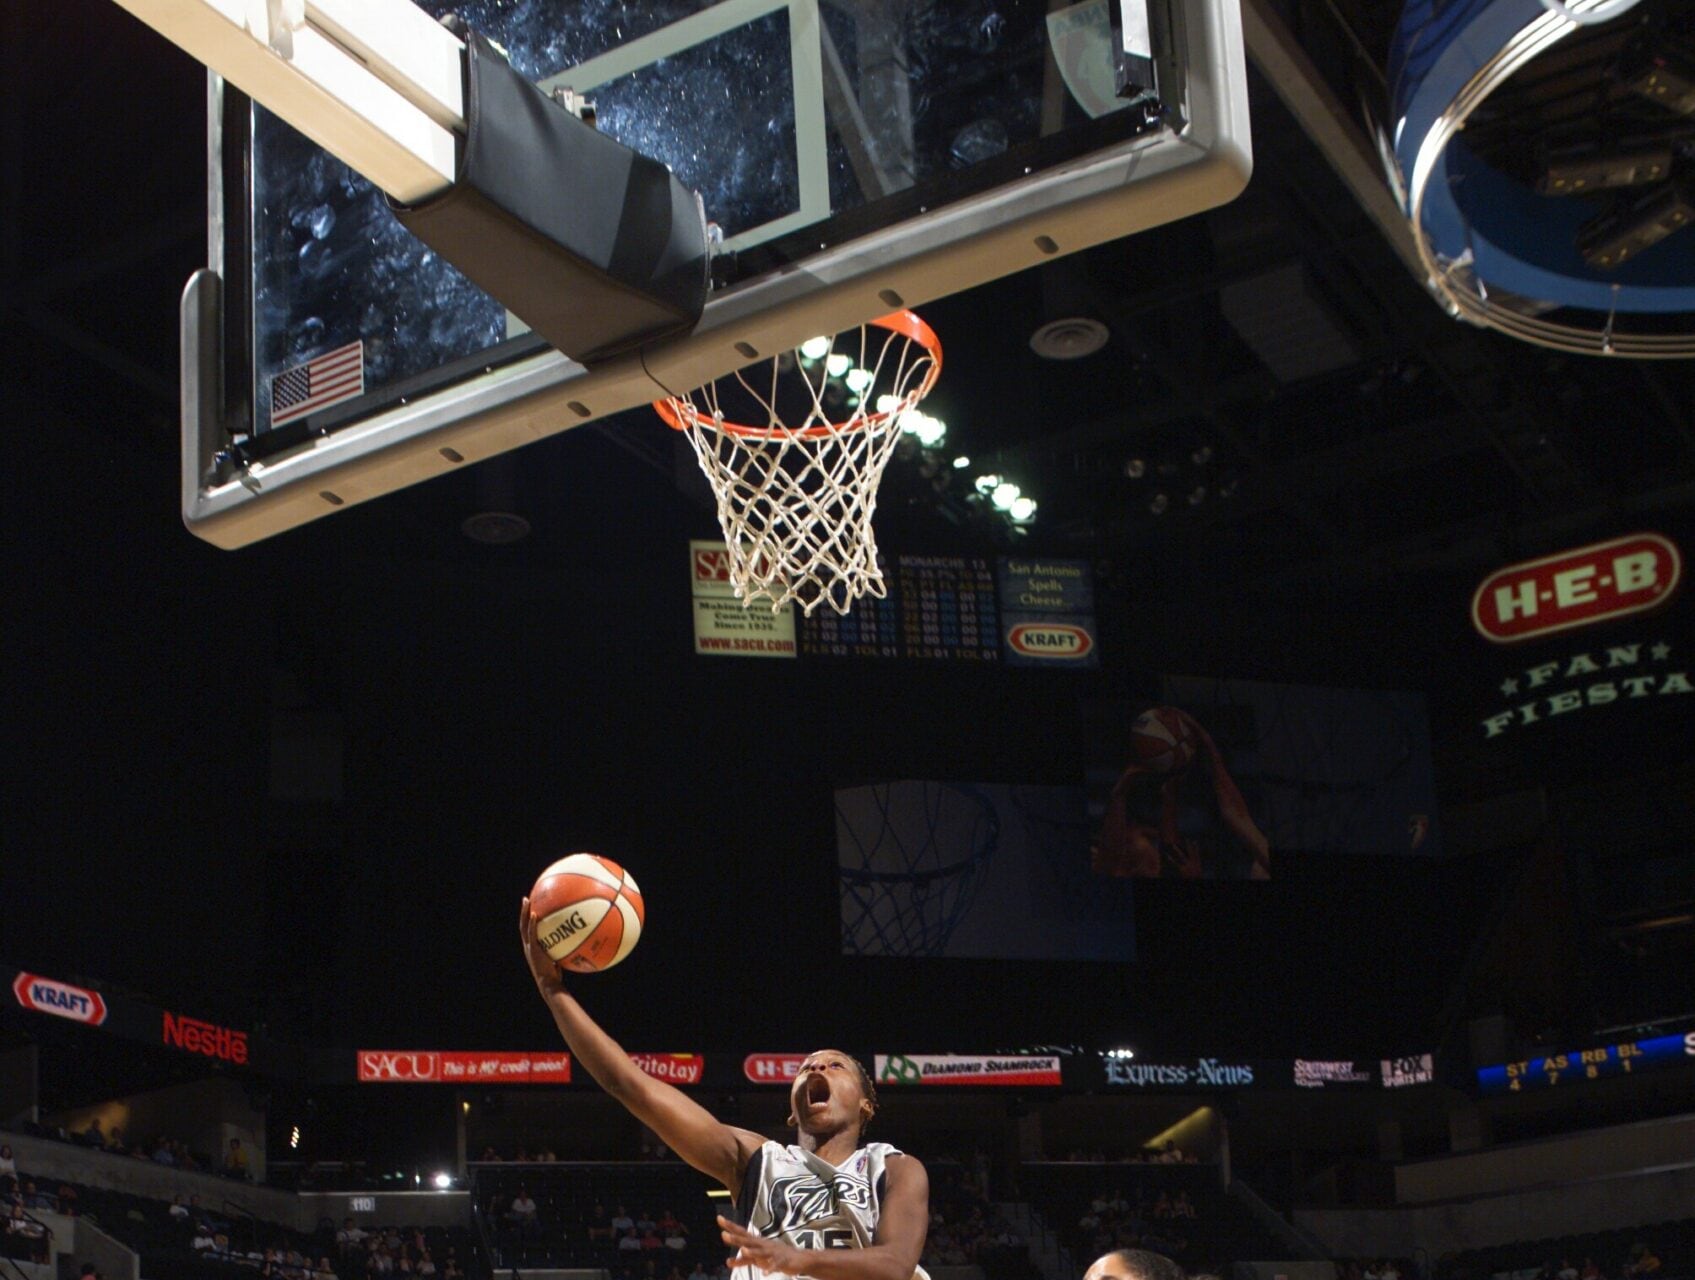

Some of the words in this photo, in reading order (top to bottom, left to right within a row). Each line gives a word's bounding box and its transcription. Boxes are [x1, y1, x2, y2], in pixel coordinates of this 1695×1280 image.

[1008, 562, 1030, 575] San
[1033, 563, 1080, 577] Antonio
[1028, 578, 1063, 592] Spells
[1495, 551, 1658, 624] H-E-B
[698, 637, 795, 652] www.sacu.com
[1024, 633, 1076, 647] KRAFT
[1526, 643, 1644, 689] FAN
[1481, 673, 1695, 739] FIESTA
[32, 983, 90, 1016] KRAFT
[363, 1055, 435, 1079] SACU
